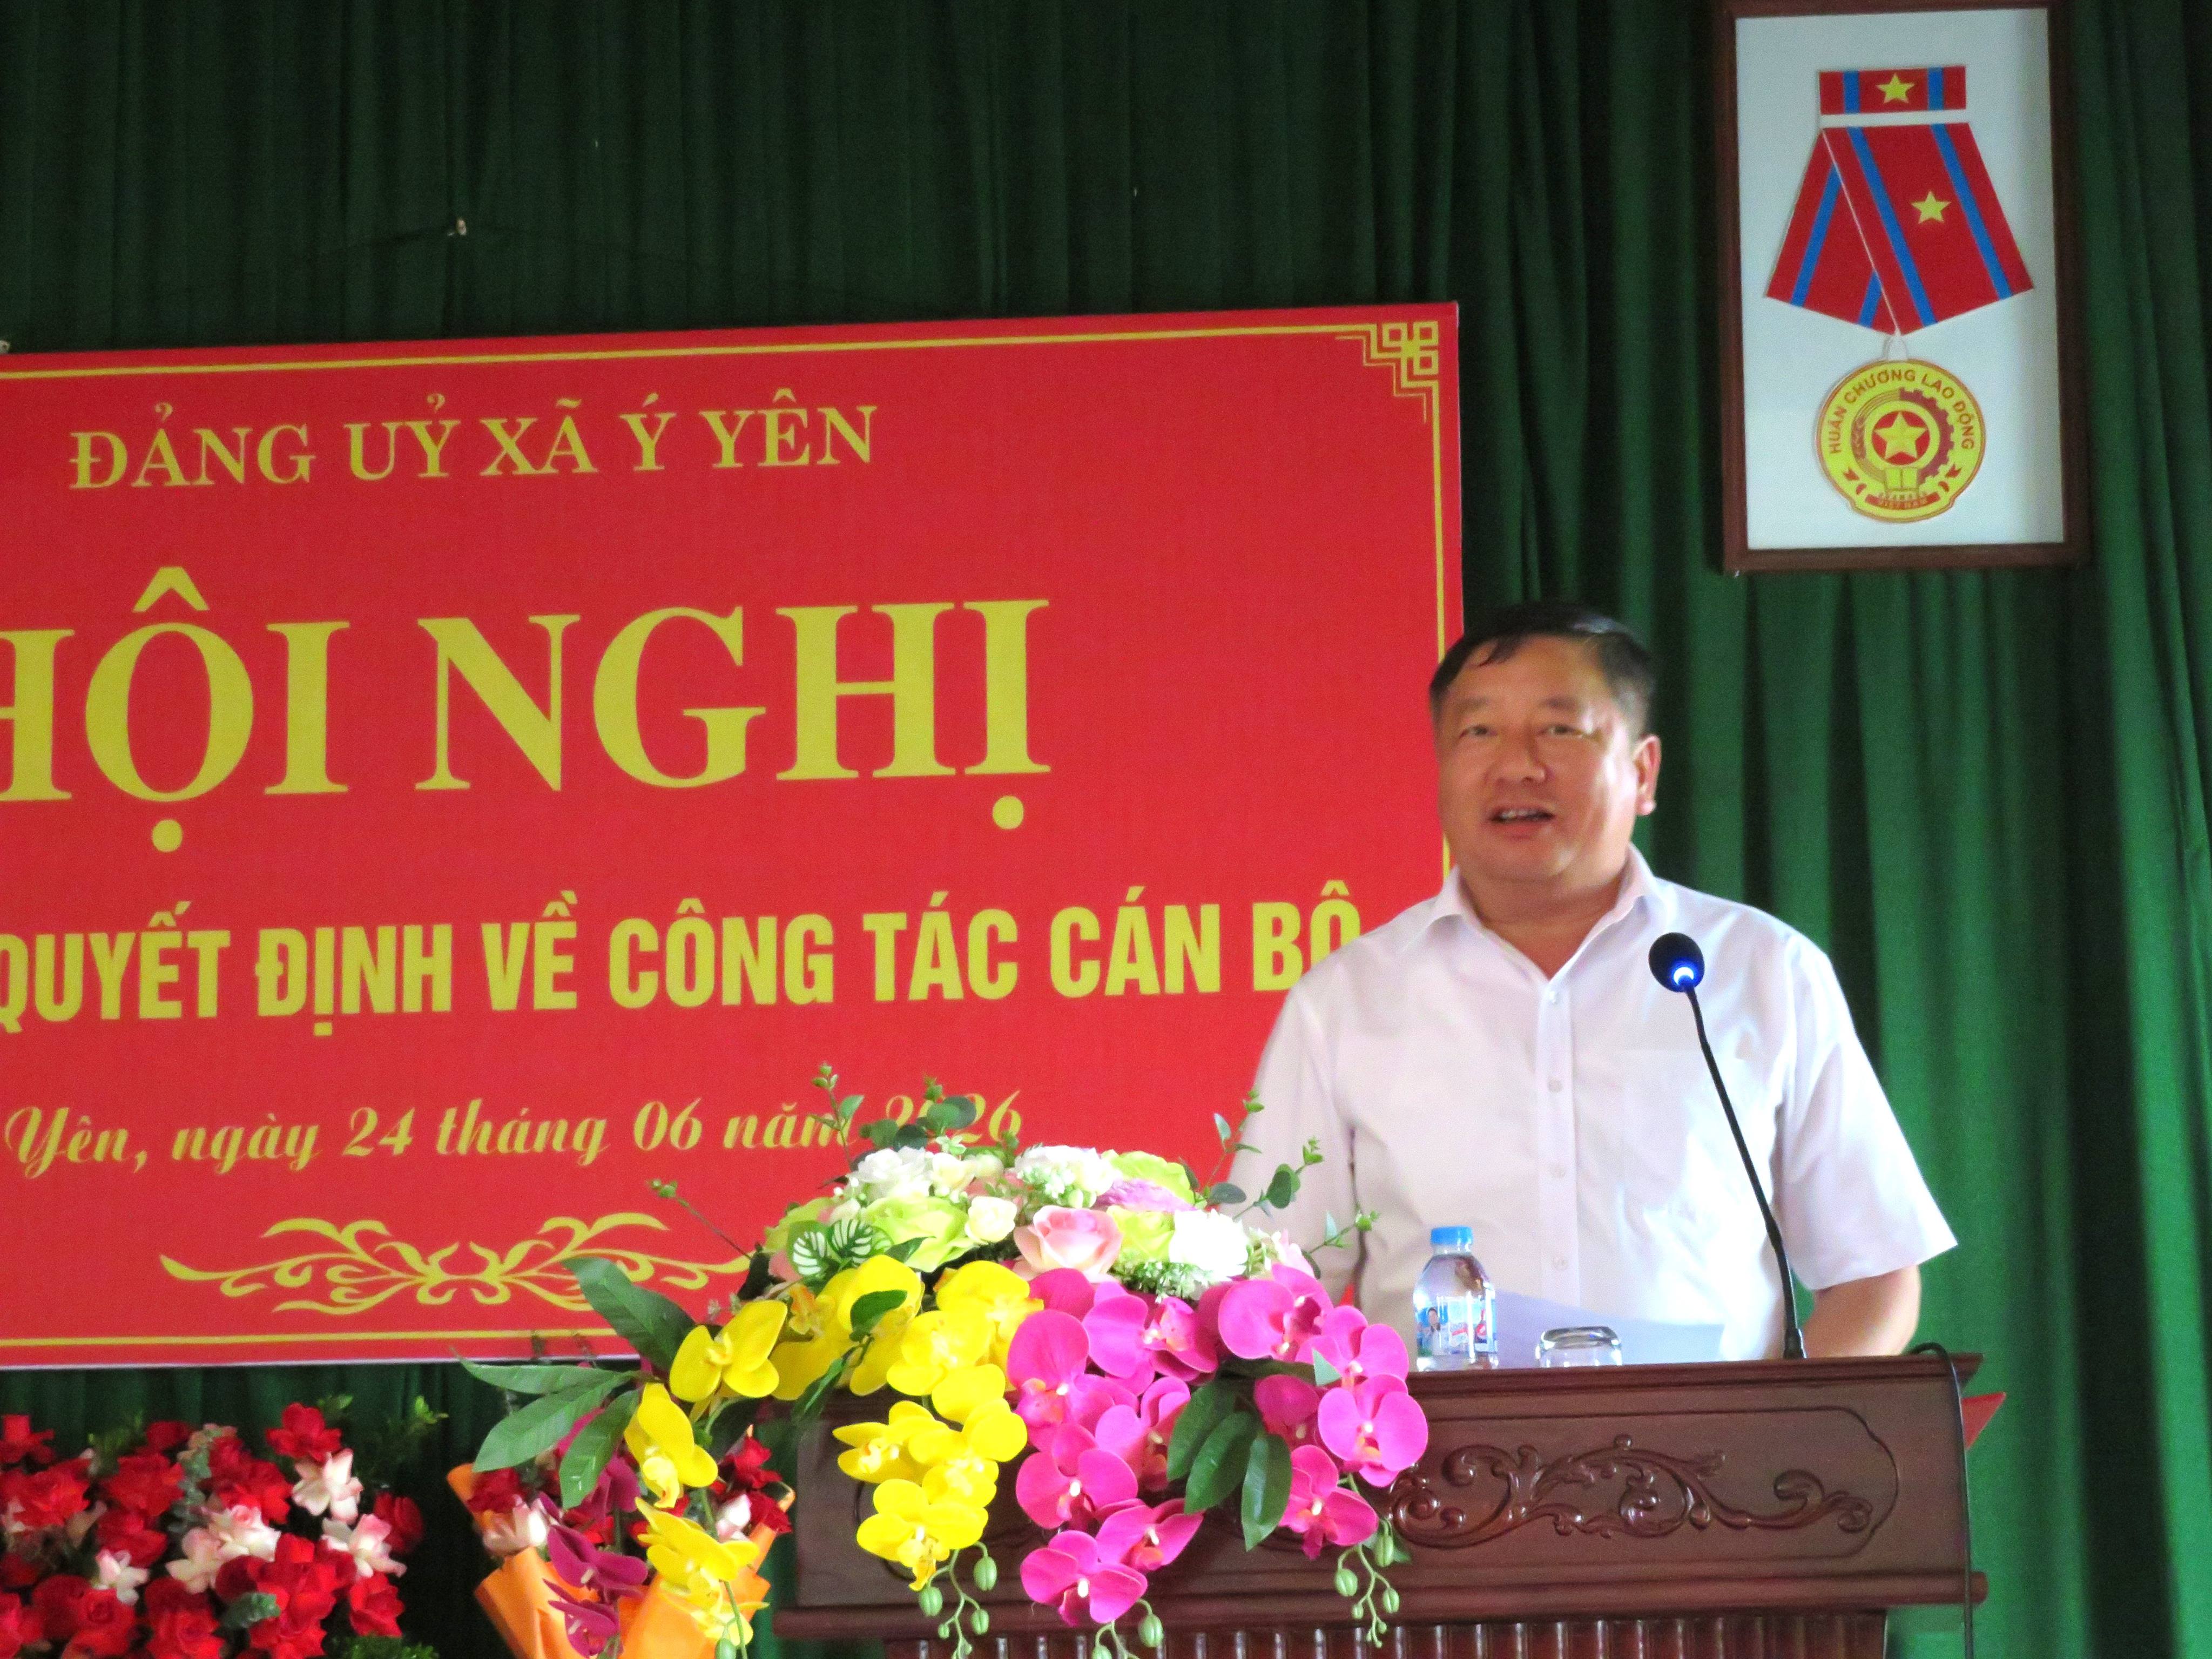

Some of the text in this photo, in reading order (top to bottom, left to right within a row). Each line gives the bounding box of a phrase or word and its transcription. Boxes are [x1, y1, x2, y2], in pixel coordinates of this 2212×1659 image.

[1921, 373, 1954, 399] LAO
[70, 387, 878, 489] ĐẢNG UỶ XÃ Ý YÊN
[415, 598, 1051, 830] NGHỊ
[0, 901, 231, 1034] QUYẾT
[254, 924, 453, 1037] ĐỊNH
[481, 890, 577, 1011] VỀ
[609, 898, 834, 1009] CÔNG
[862, 891, 1019, 1002] TÁC
[1049, 885, 1221, 999] CÁN
[4, 1106, 148, 1179] Yên,
[171, 1112, 321, 1175] ngày
[342, 1106, 415, 1157] 24
[435, 1098, 610, 1166] tháng
[633, 1097, 702, 1151] 06
[722, 1101, 853, 1149] năm
